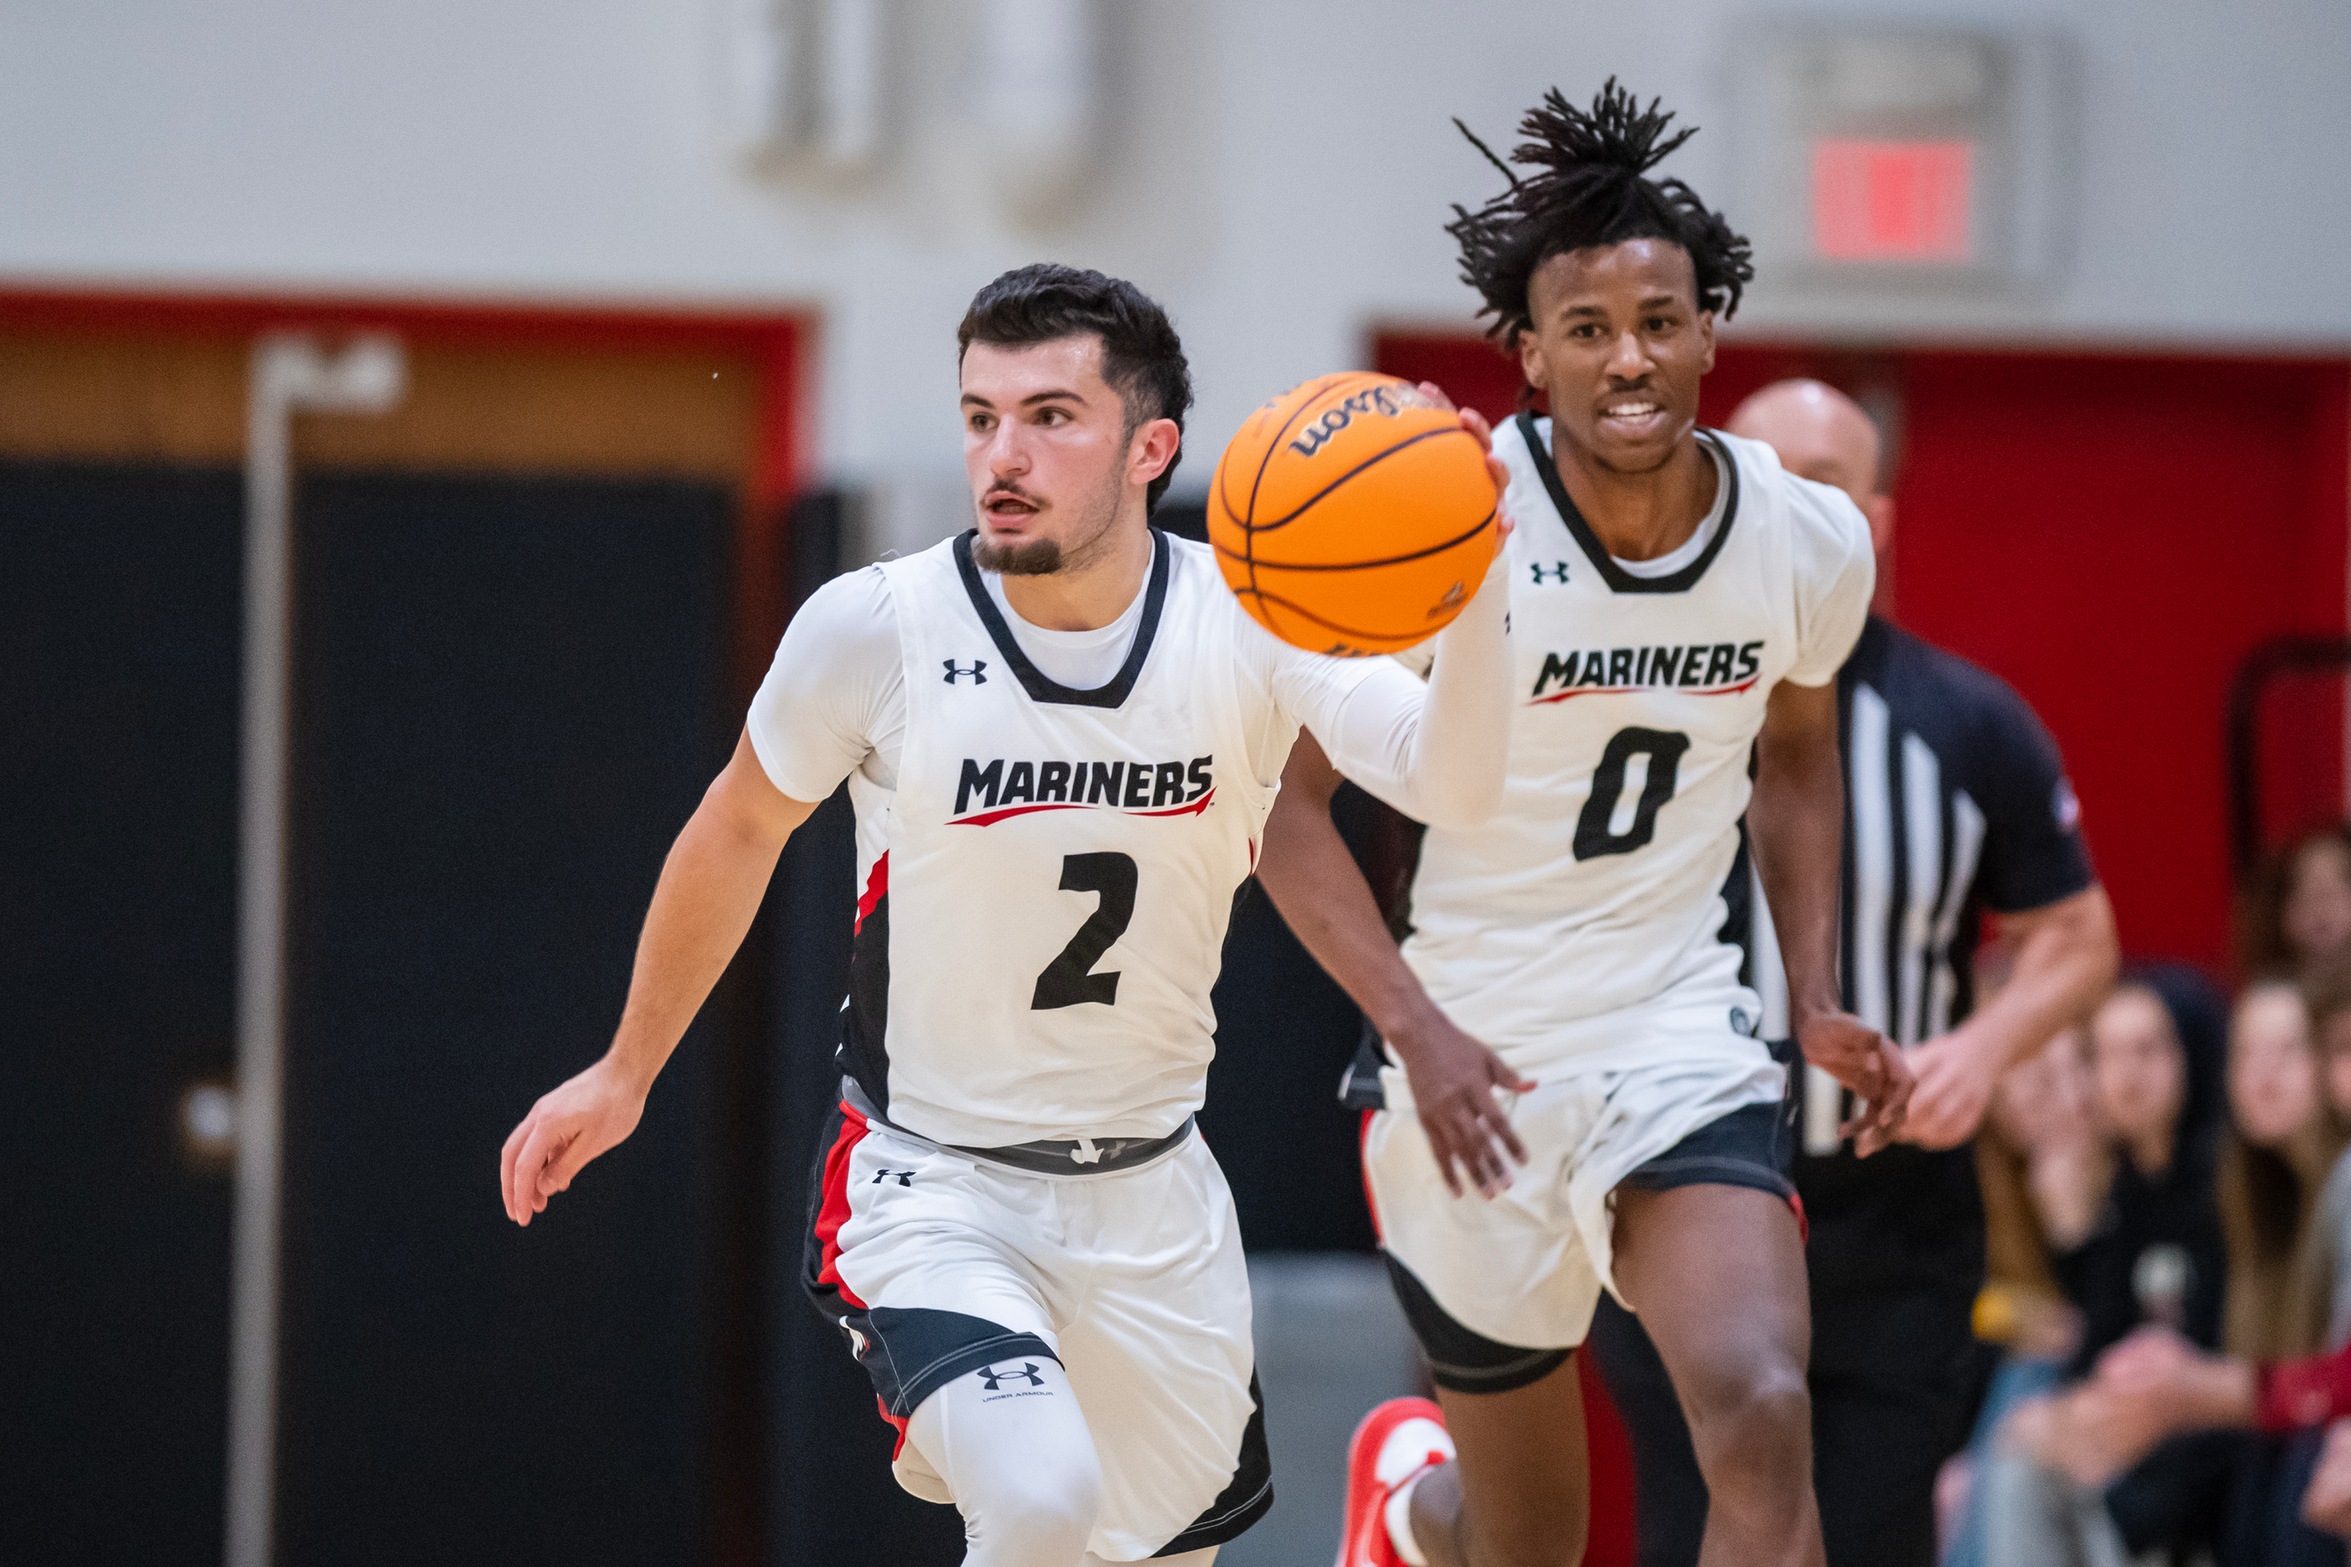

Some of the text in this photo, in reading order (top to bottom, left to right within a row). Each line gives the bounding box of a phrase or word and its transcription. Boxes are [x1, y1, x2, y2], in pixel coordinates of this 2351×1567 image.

[1531, 640, 1764, 697] MARINERS
[953, 754, 1213, 815] MARINERS
[1572, 725, 1691, 862] 0
[1031, 851, 1139, 1010] 2
[982, 1393, 1013, 1403] UNDER
